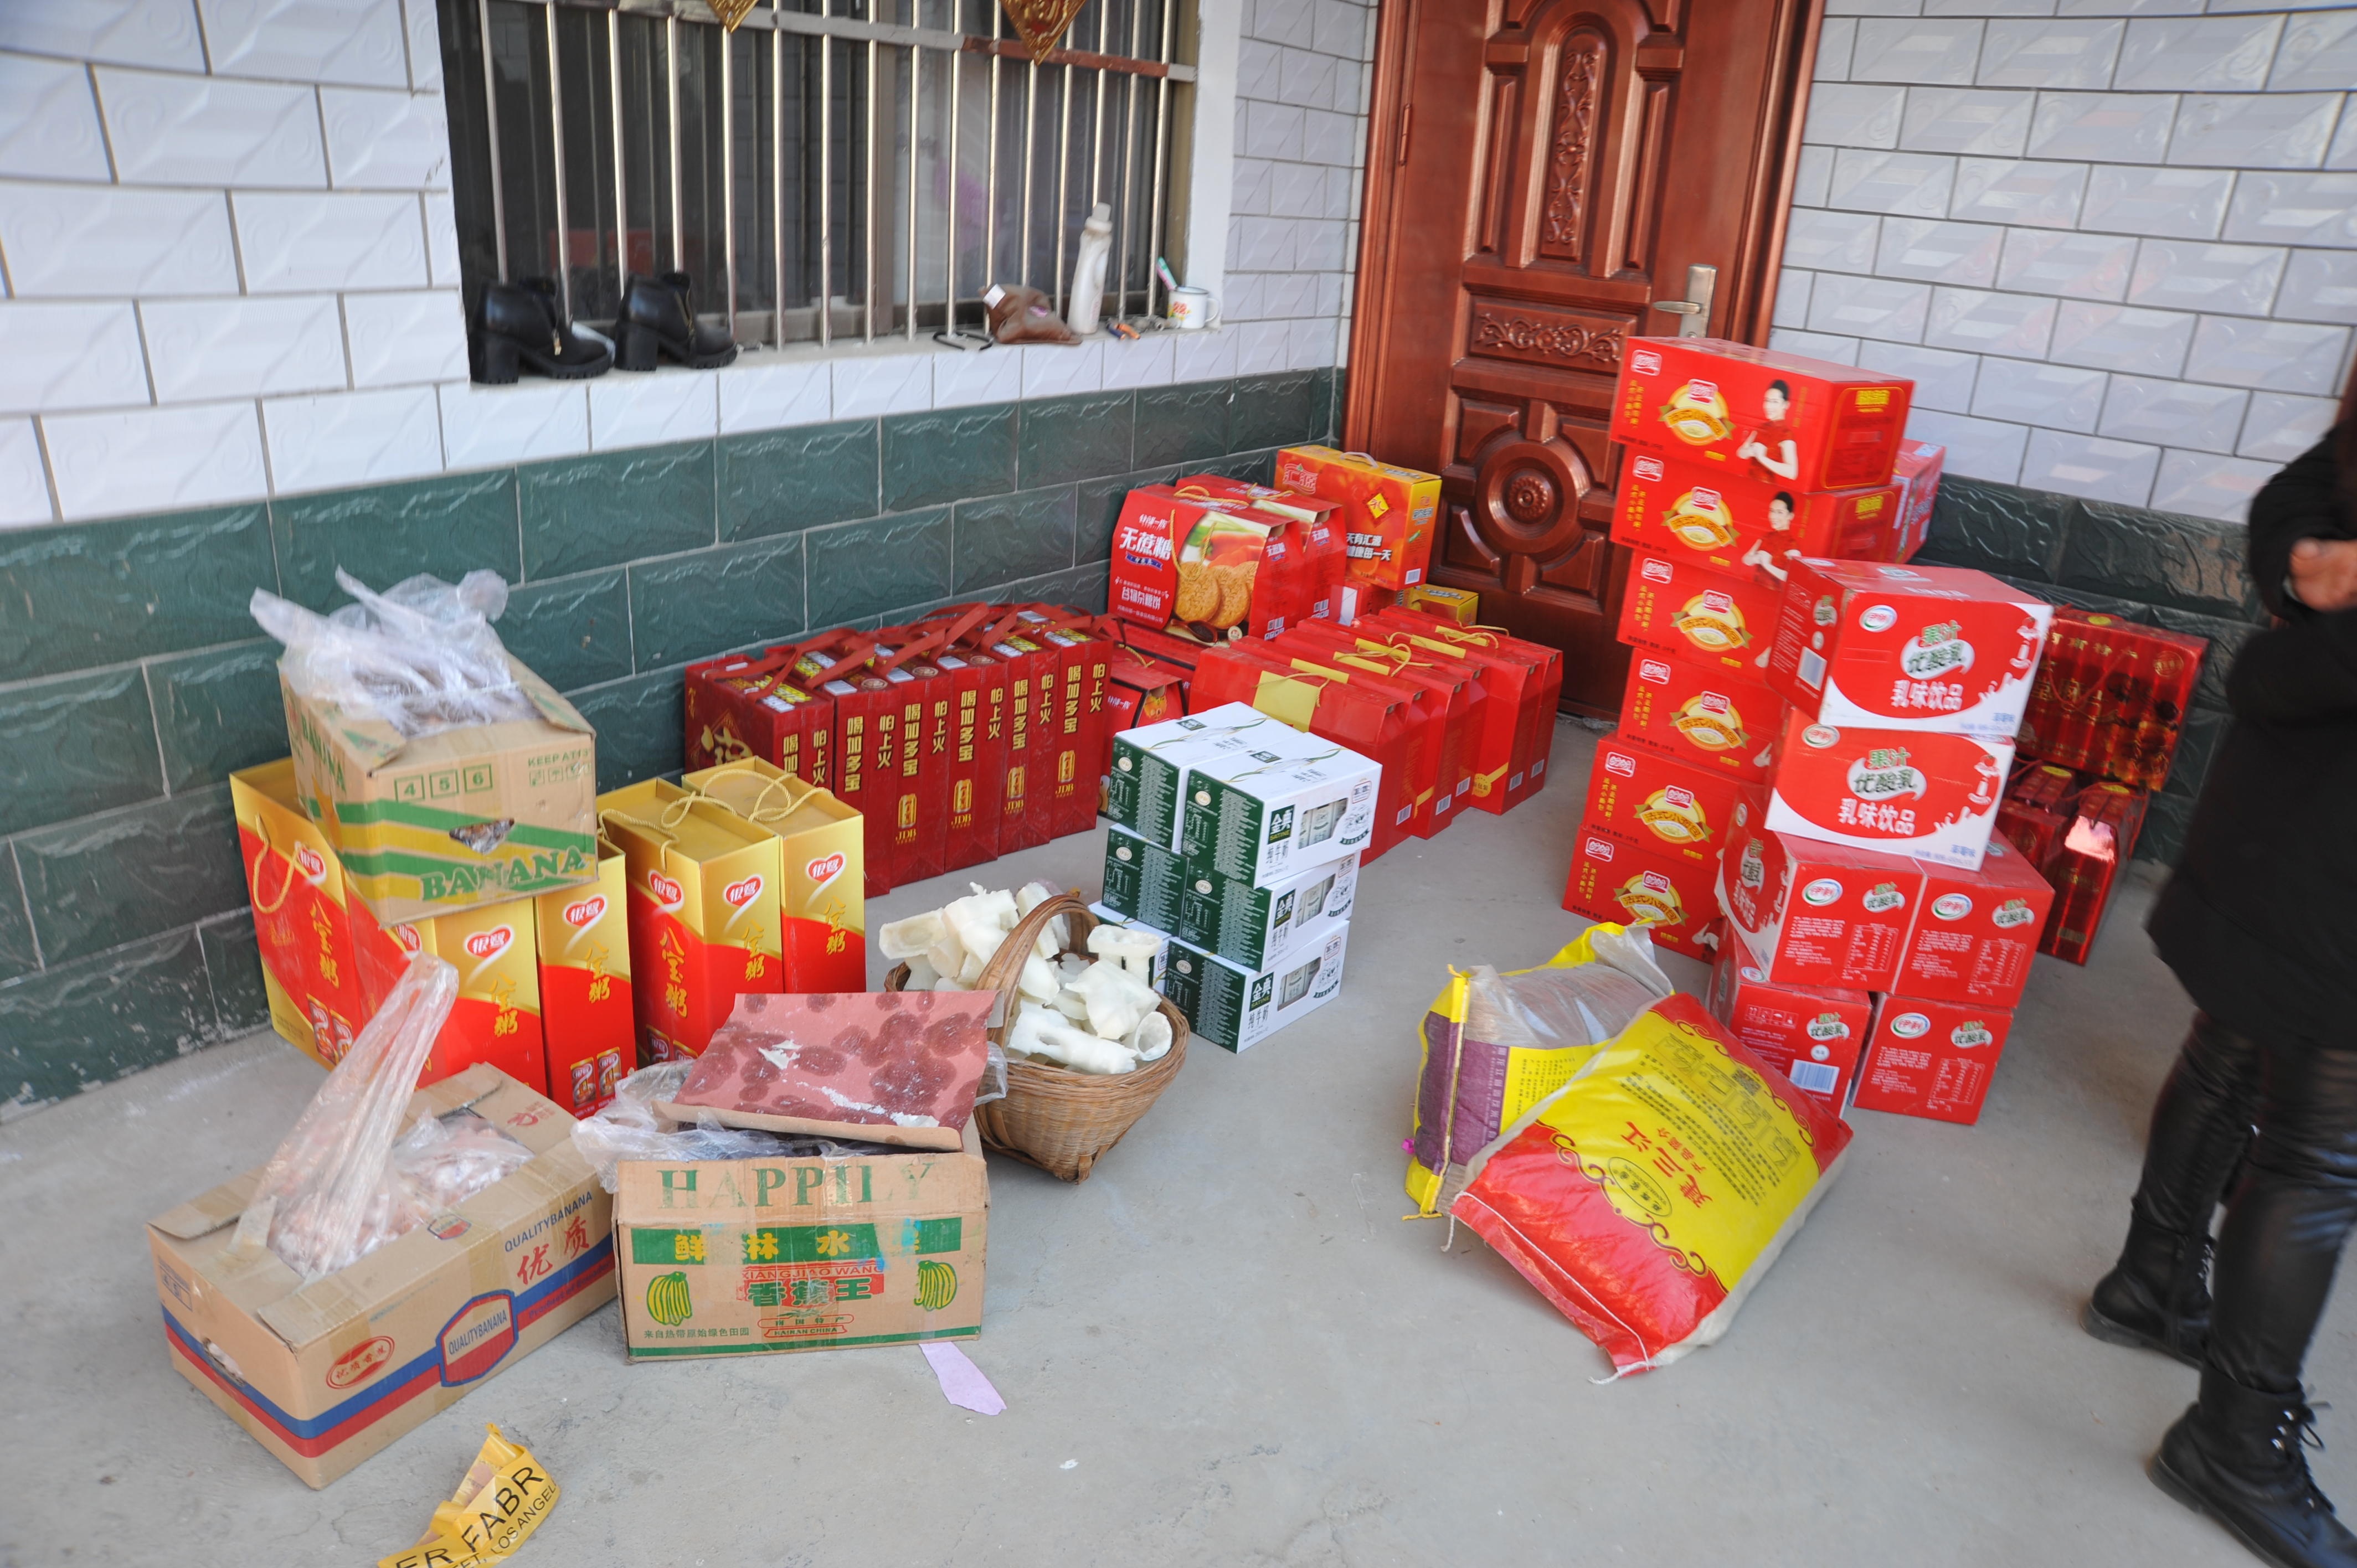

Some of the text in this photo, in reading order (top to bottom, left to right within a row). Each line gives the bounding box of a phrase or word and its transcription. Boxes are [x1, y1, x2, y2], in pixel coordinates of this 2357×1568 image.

[1119, 527, 1172, 560] 无蔗糖
[1921, 620, 1962, 646] 果汁
[1907, 641, 1965, 673] 优酸乳
[1039, 674, 1053, 725] 怕上火
[1063, 665, 1082, 734] 喝加多宝
[1089, 663, 1105, 713] 怕上火
[1891, 679, 1964, 710] 乳味饮品
[932, 701, 948, 754] 怕上火
[958, 690, 977, 762] 喝加多宝
[987, 688, 1003, 740] 怕上火
[1012, 679, 1028, 750] 喝加多宝
[845, 716, 863, 792] 喝加多宝
[877, 715, 895, 770] 怕上火
[903, 703, 921, 776] 喝加多宝
[528, 754, 560, 767] KEEP
[812, 730, 827, 786] 怕上火
[1868, 746, 1911, 769] 果汁
[404, 772, 483, 796] 4 5 6
[1056, 783, 1074, 795] JDB
[1854, 768, 1917, 795] 优酸乳
[951, 814, 971, 826] JDB
[1005, 800, 1023, 811] JDB
[1271, 808, 1291, 834] 金典
[1838, 797, 1917, 837] 乳味饮品
[896, 829, 917, 840] JDB
[1270, 831, 1290, 840] SATINE
[1644, 811, 1701, 837] 法式小面包
[420, 845, 586, 902] BANANA
[811, 858, 840, 877] 银鹭
[653, 878, 678, 903] 银鹭
[729, 880, 758, 901] 银鹭
[1276, 894, 1292, 919] 金典
[569, 900, 602, 923] 银鹭
[1624, 895, 1676, 921] 法式小面包
[471, 930, 505, 953] 银鹭
[824, 896, 846, 956] 八宝粥
[742, 920, 765, 982] 八宝粥
[585, 940, 611, 1004] 八宝粥
[660, 926, 688, 1018] 八宝粥
[489, 973, 518, 1037] 八宝粥
[1251, 997, 1270, 1008] SATINE
[1252, 977, 1272, 1003] 金典
[1621, 1121, 1713, 1208] 建三江
[1657, 1127, 1706, 1174] 产品简介
[505, 1191, 593, 1252] QUALITYBANANA
[517, 1215, 590, 1285] 优质
[675, 1230, 919, 1261] 鲜林水
[748, 1278, 872, 1307] 香蕉王
[448, 1309, 508, 1355] QUALITYBANANA
[644, 1327, 749, 1339] 来自热带原始绿色田园
[491, 1527, 517, 1555] LOS
[518, 1482, 557, 1530] ANGEL
